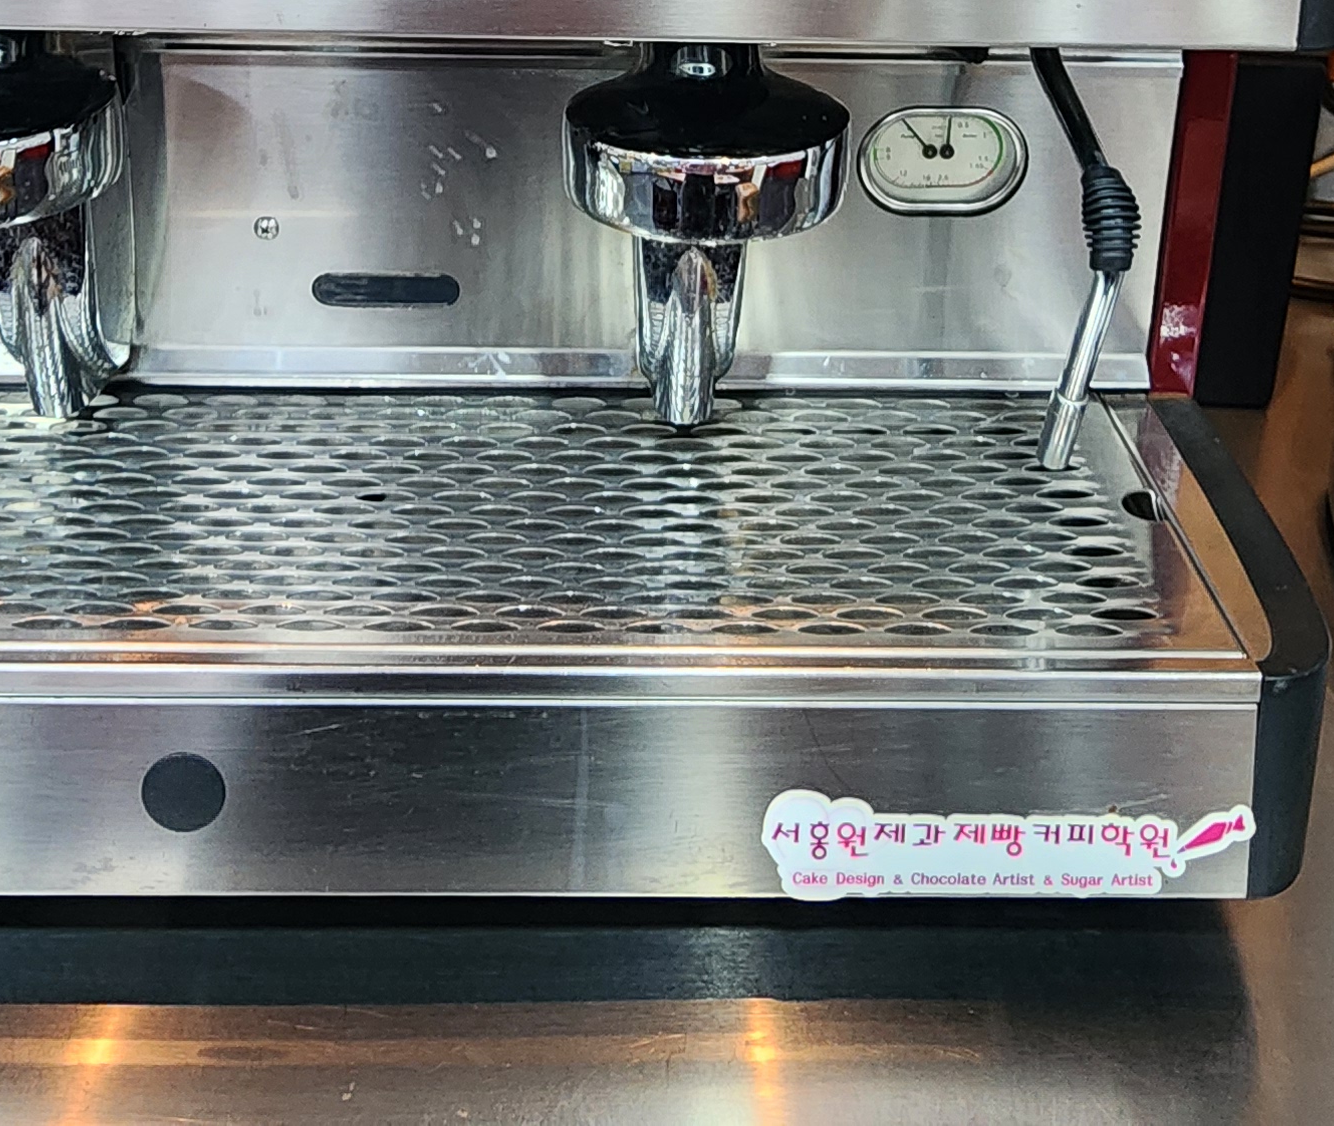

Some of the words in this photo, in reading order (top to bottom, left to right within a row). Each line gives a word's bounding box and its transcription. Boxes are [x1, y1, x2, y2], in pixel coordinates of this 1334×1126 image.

[792, 872, 827, 885] Cake
[835, 872, 884, 887] Design
[893, 874, 904, 885] &
[911, 872, 987, 886] Chocolate
[992, 873, 1035, 886] Artist
[1043, 875, 1054, 886] &
[1061, 873, 1104, 889] Sugar
[1111, 873, 1153, 887] Artist
